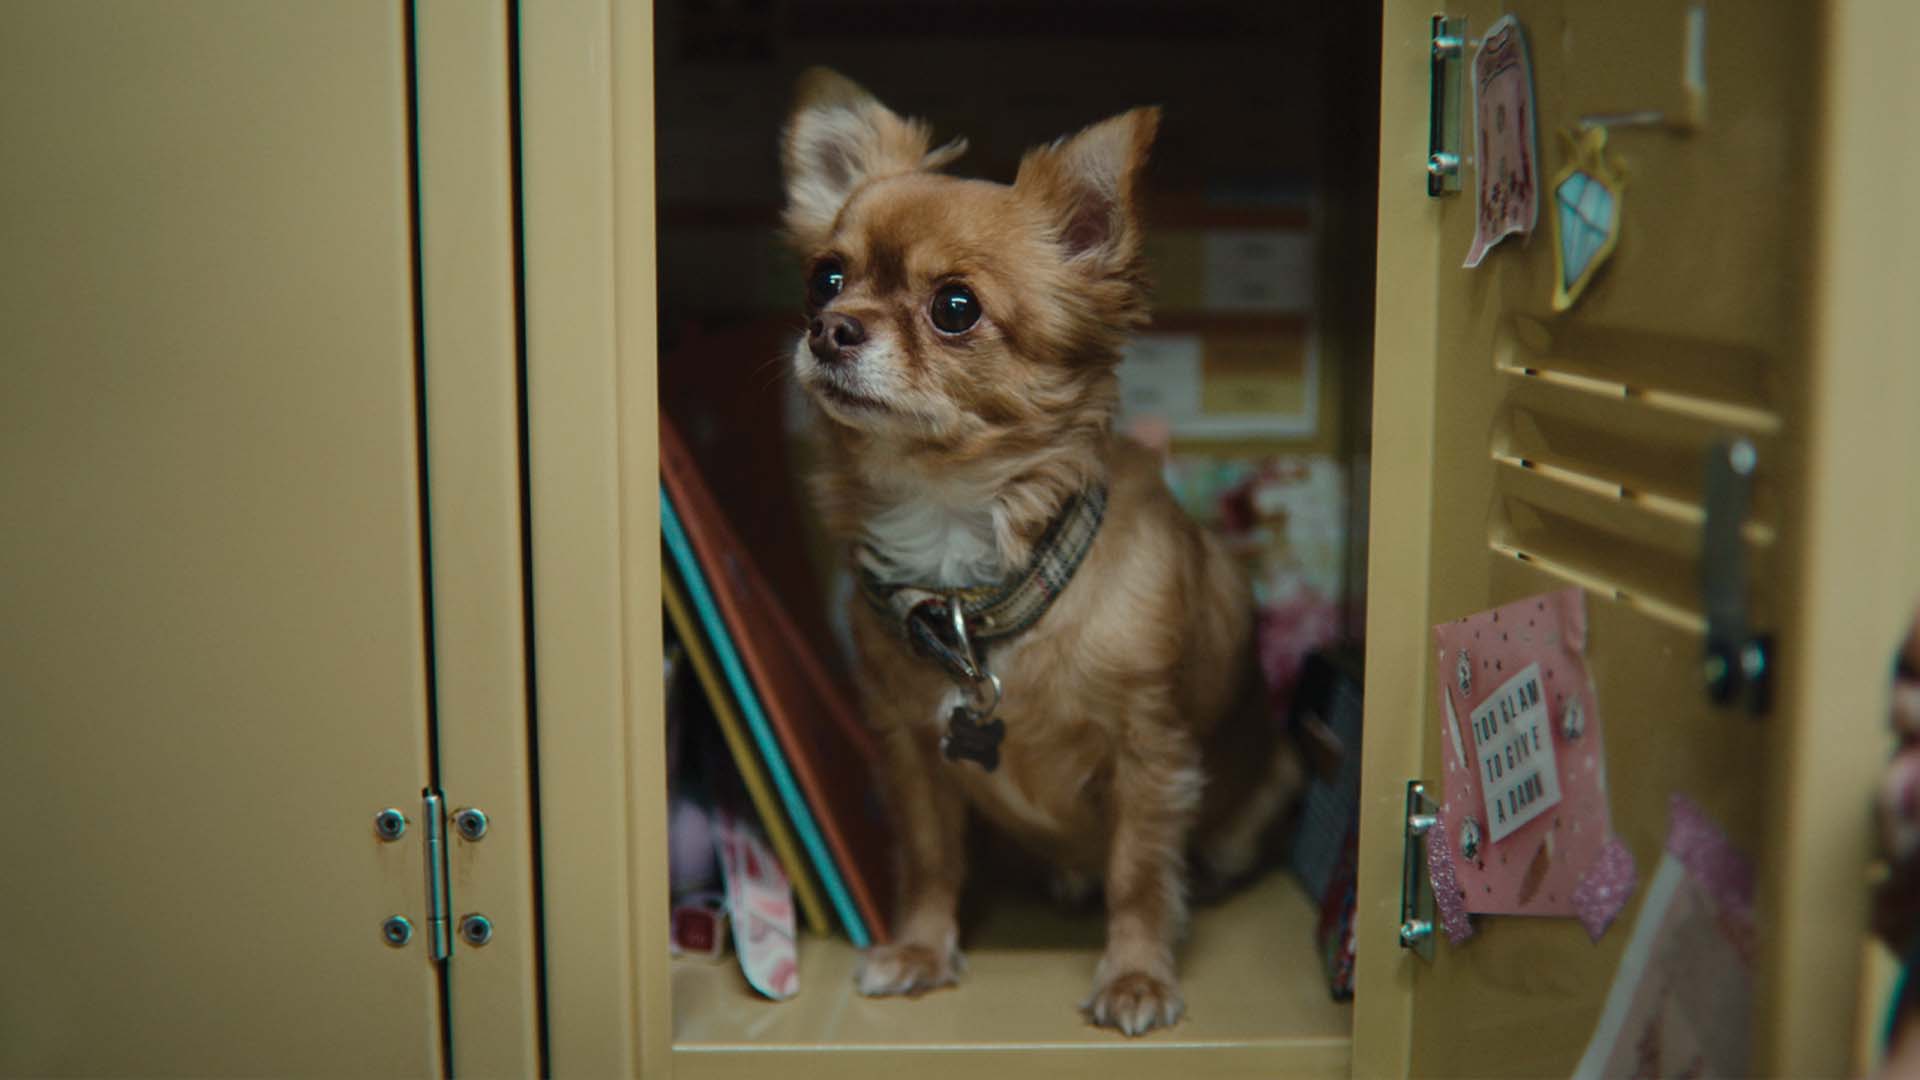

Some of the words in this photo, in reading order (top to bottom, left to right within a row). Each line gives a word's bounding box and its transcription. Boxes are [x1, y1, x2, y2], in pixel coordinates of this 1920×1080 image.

[1473, 710, 1497, 745] TOO
[1501, 679, 1540, 723] GLAM
[1485, 755, 1502, 782] TO
[1505, 727, 1541, 770] GIVE
[1496, 799, 1506, 824] A
[1509, 773, 1543, 816] DAMN
